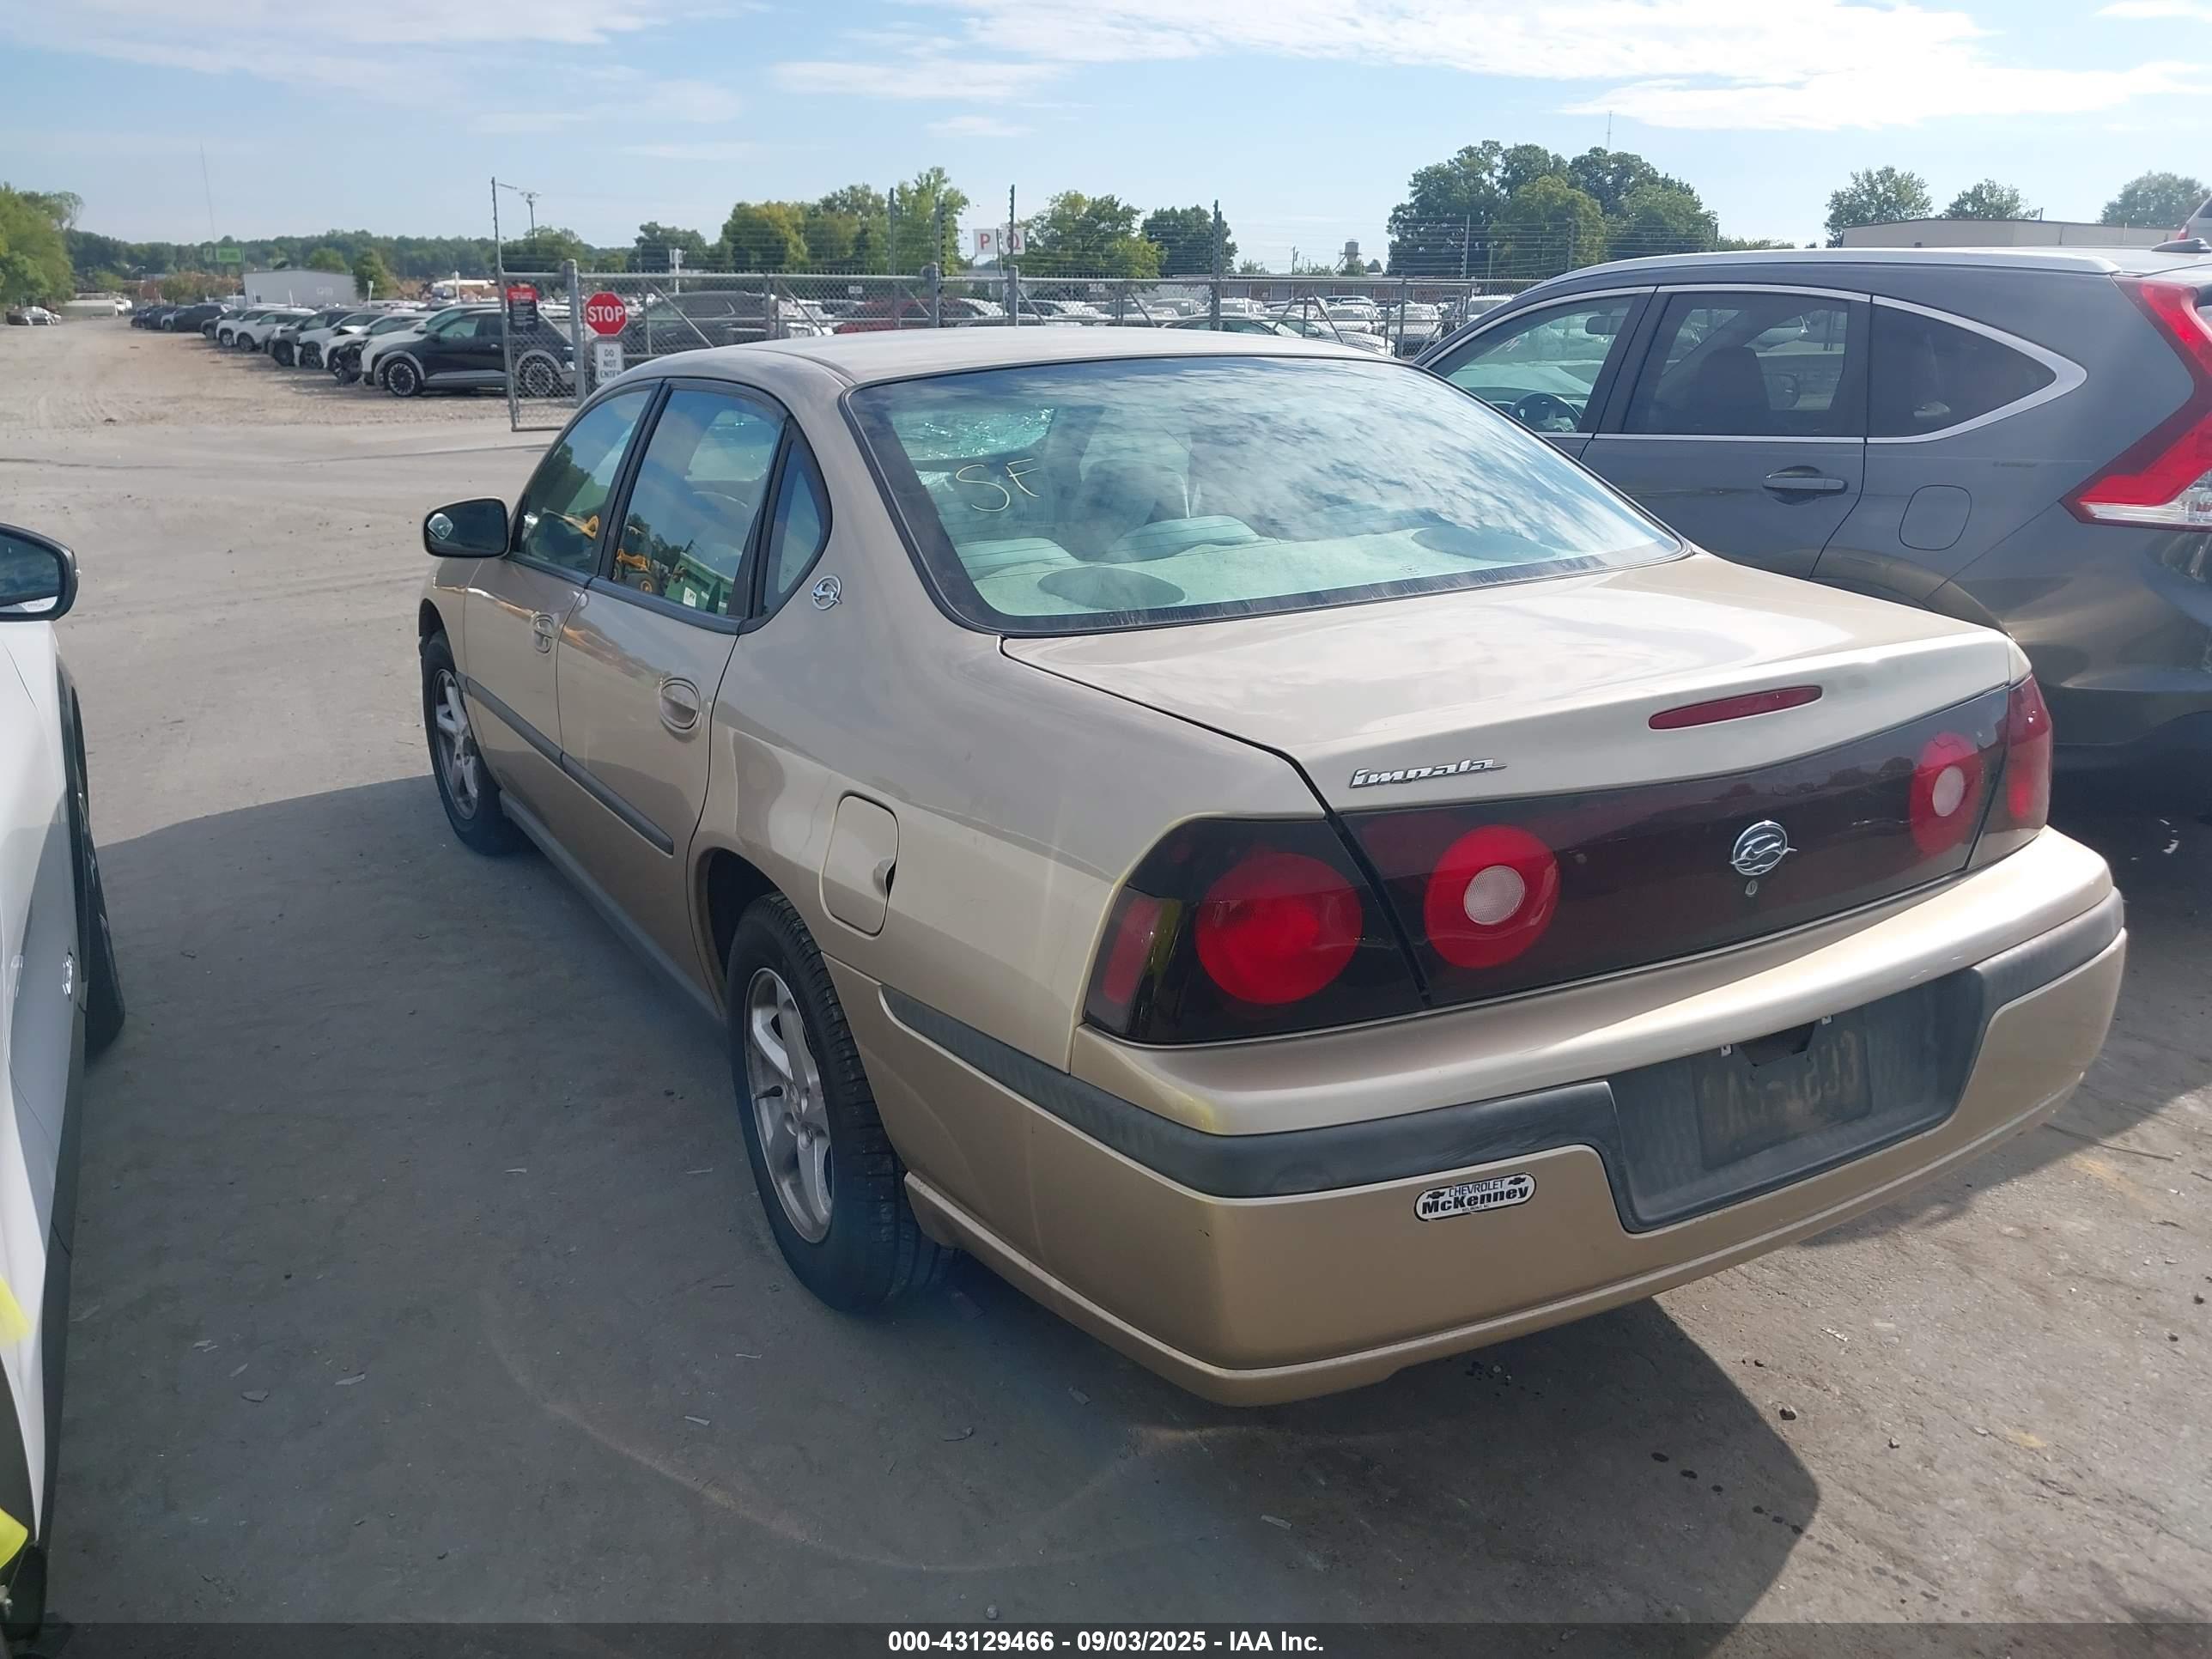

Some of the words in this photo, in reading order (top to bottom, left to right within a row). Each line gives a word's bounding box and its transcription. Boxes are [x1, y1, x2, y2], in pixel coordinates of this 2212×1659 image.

[980, 233, 991, 250] P
[1006, 233, 1021, 250] Q
[587, 306, 624, 322] STOP
[605, 349, 615, 357] DO
[603, 359, 617, 368] NOT
[1449, 1179, 1504, 1198] CHEVROLET
[1421, 1186, 1529, 1215] McKenney
